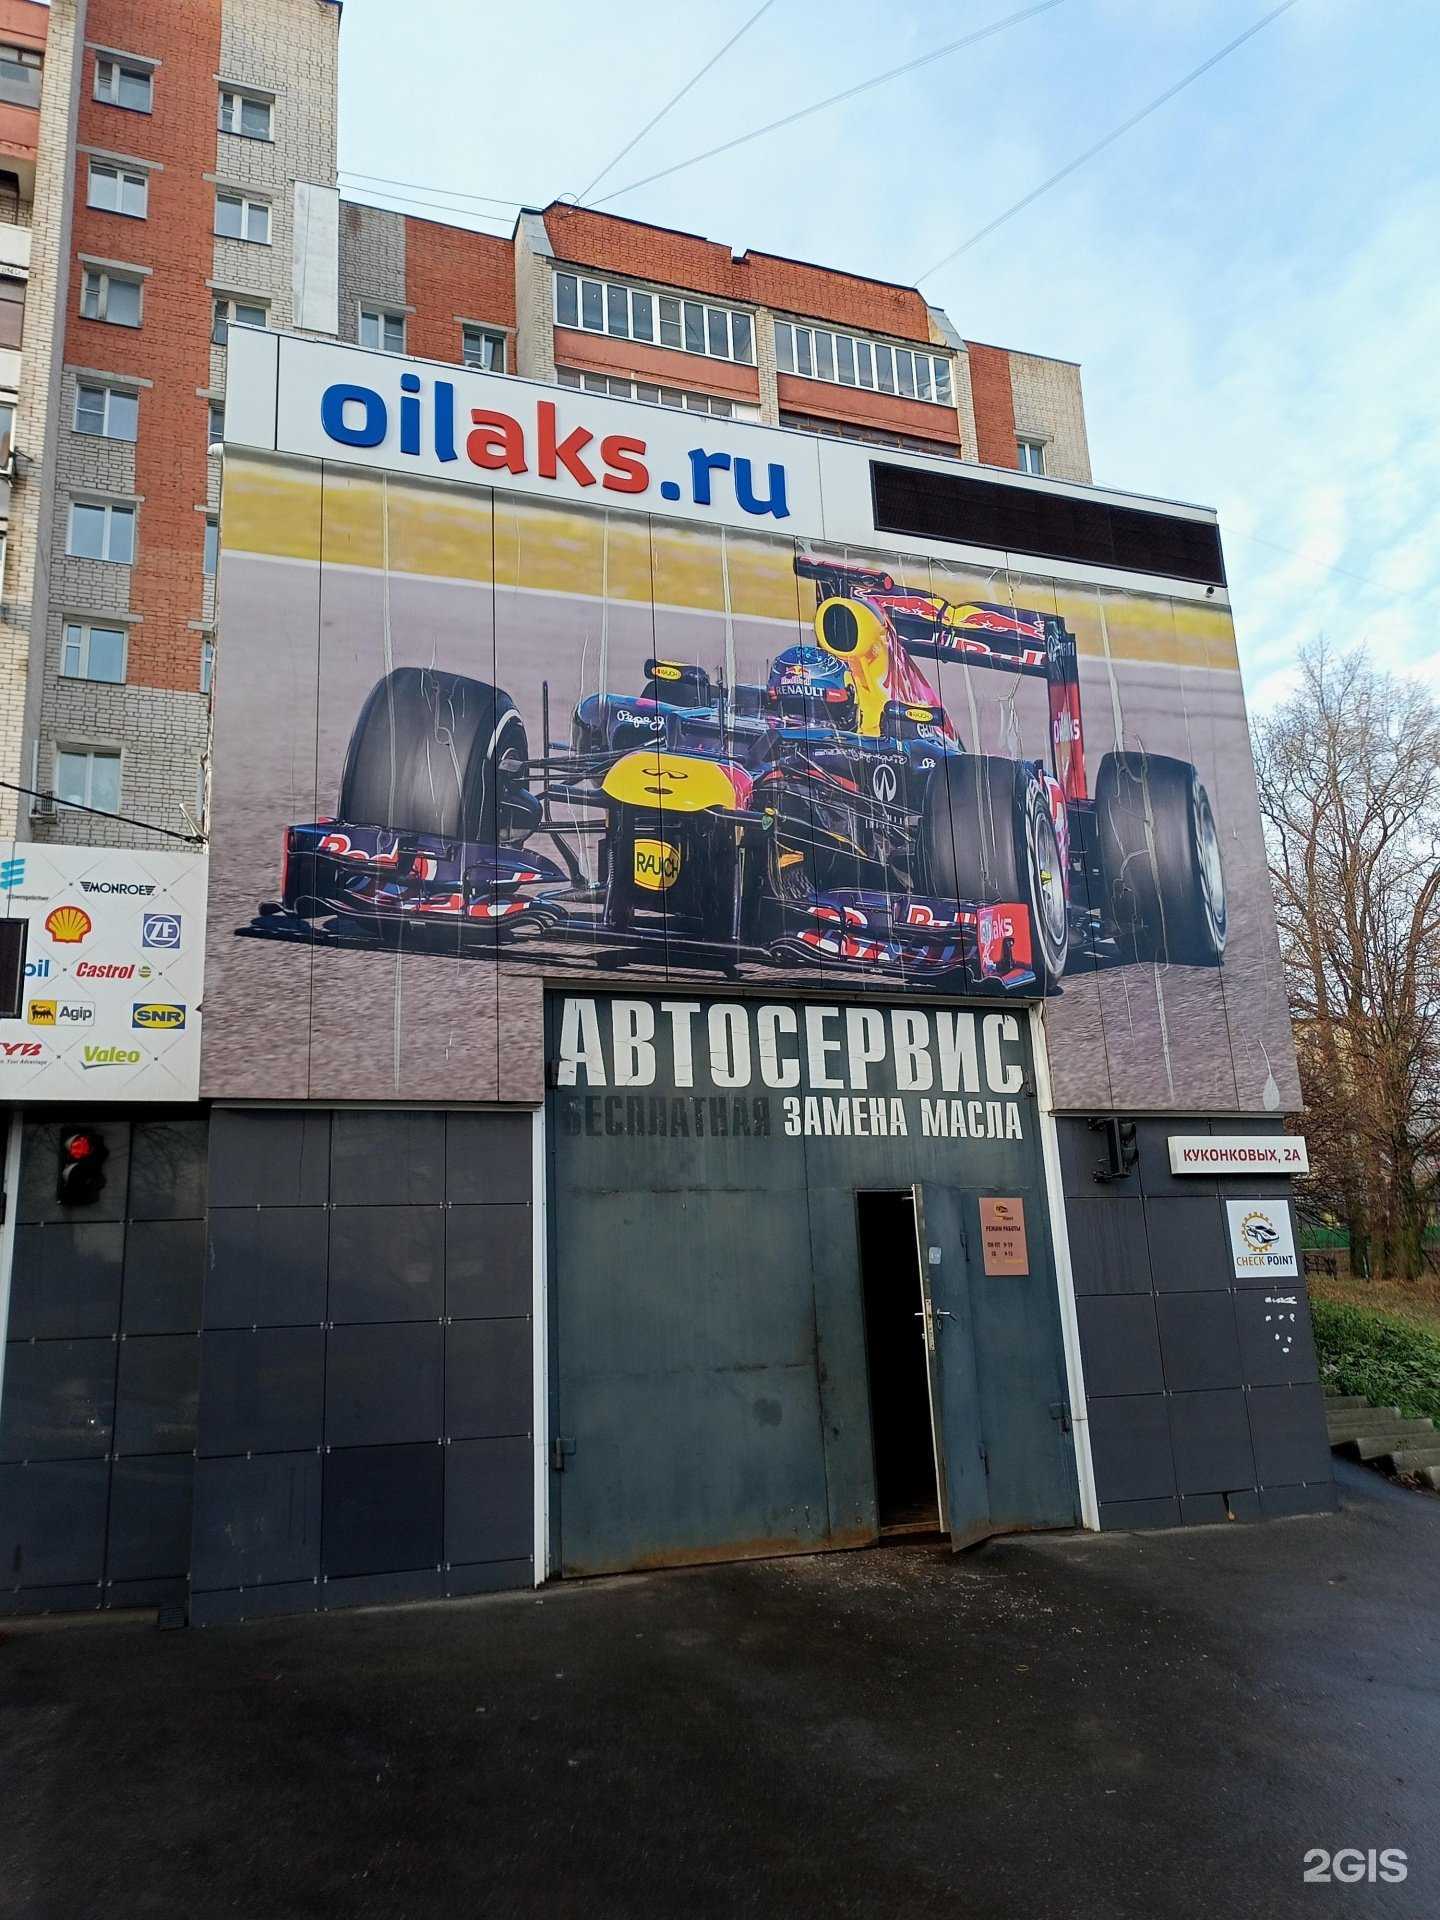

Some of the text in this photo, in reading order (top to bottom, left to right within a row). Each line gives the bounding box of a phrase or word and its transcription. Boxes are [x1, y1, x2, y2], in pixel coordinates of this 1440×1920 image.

[321, 373, 790, 519] oilaks.ru
[776, 685, 824, 697] RENAULT
[636, 852, 679, 878] RAUCH
[89, 882, 146, 896] MONROE
[149, 921, 176, 939] ZF
[76, 962, 136, 979] Castrol
[59, 1006, 92, 1021] Agip
[136, 1010, 182, 1022] SNR
[83, 1045, 141, 1064] Valeo
[557, 998, 1024, 1094] АВТОСЕРВИС
[560, 1095, 1024, 1140] БЕСПЛАТНАЯ ЗАМЕНА МАСЛА
[1183, 1148, 1301, 1163] КУКОНКОВЫХ, 2А
[1236, 1255, 1294, 1266] CHECK POINT
